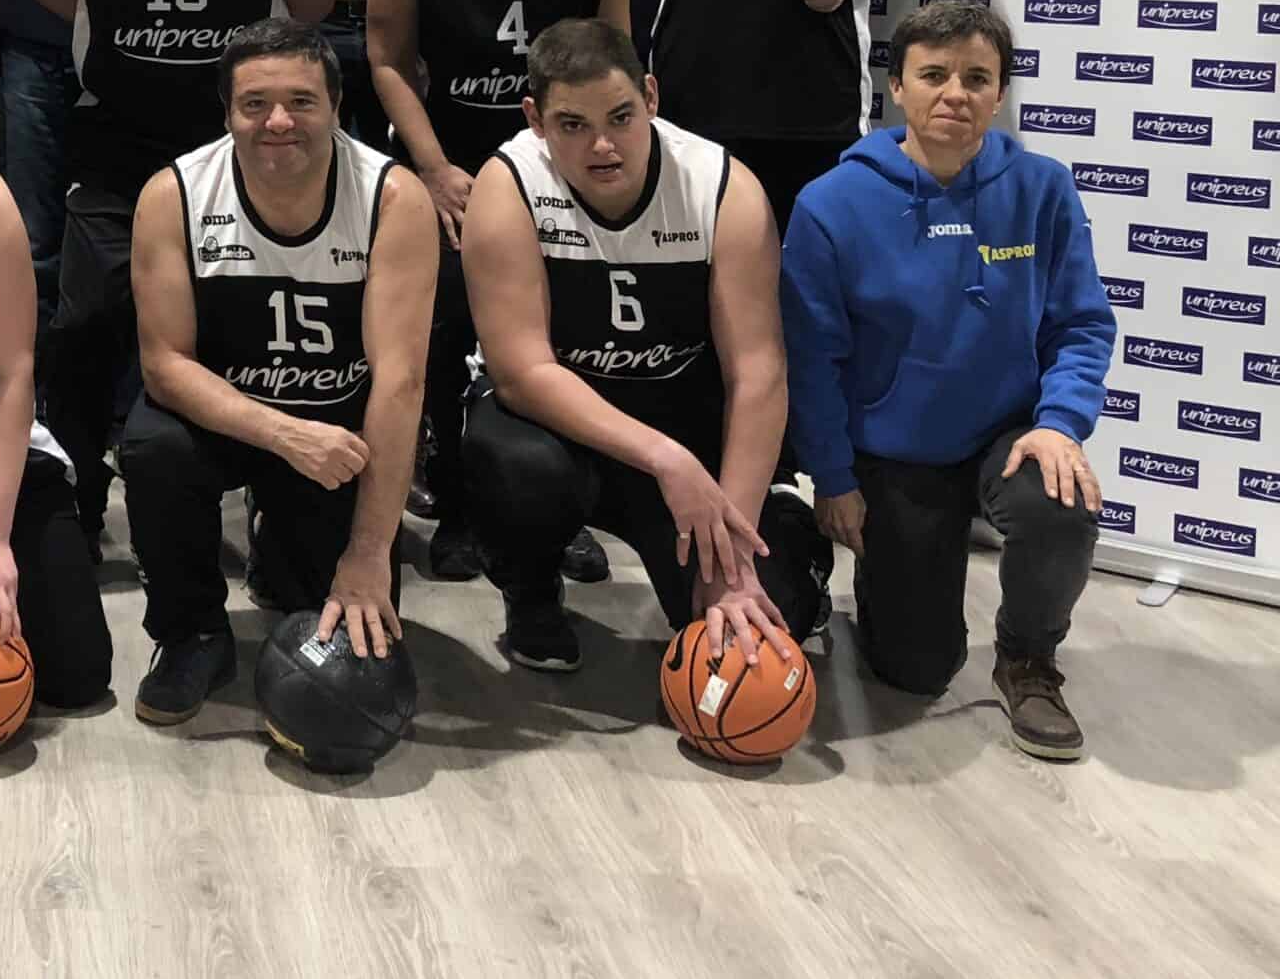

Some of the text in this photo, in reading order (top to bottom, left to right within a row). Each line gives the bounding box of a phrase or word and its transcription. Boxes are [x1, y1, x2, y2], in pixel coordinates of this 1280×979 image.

[1141, 3, 1214, 21] unipreus
[496, 0, 529, 55] 4
[1079, 56, 1150, 74] unipreus
[1194, 62, 1272, 82] unipreus
[449, 67, 529, 103] unipr
[1022, 107, 1092, 126] unipreus
[1135, 115, 1208, 135] unipreus
[1074, 167, 1145, 186] unipreus
[1189, 177, 1267, 198] unipreus
[1131, 228, 1204, 249] unipreus
[608, 270, 646, 332] 6
[1185, 292, 1262, 314] unipreus
[266, 290, 335, 355] 15
[1127, 341, 1199, 364] unipreus
[1181, 407, 1257, 430] unipreus
[1122, 454, 1195, 478] unipreus
[1177, 521, 1253, 545] unipreus
